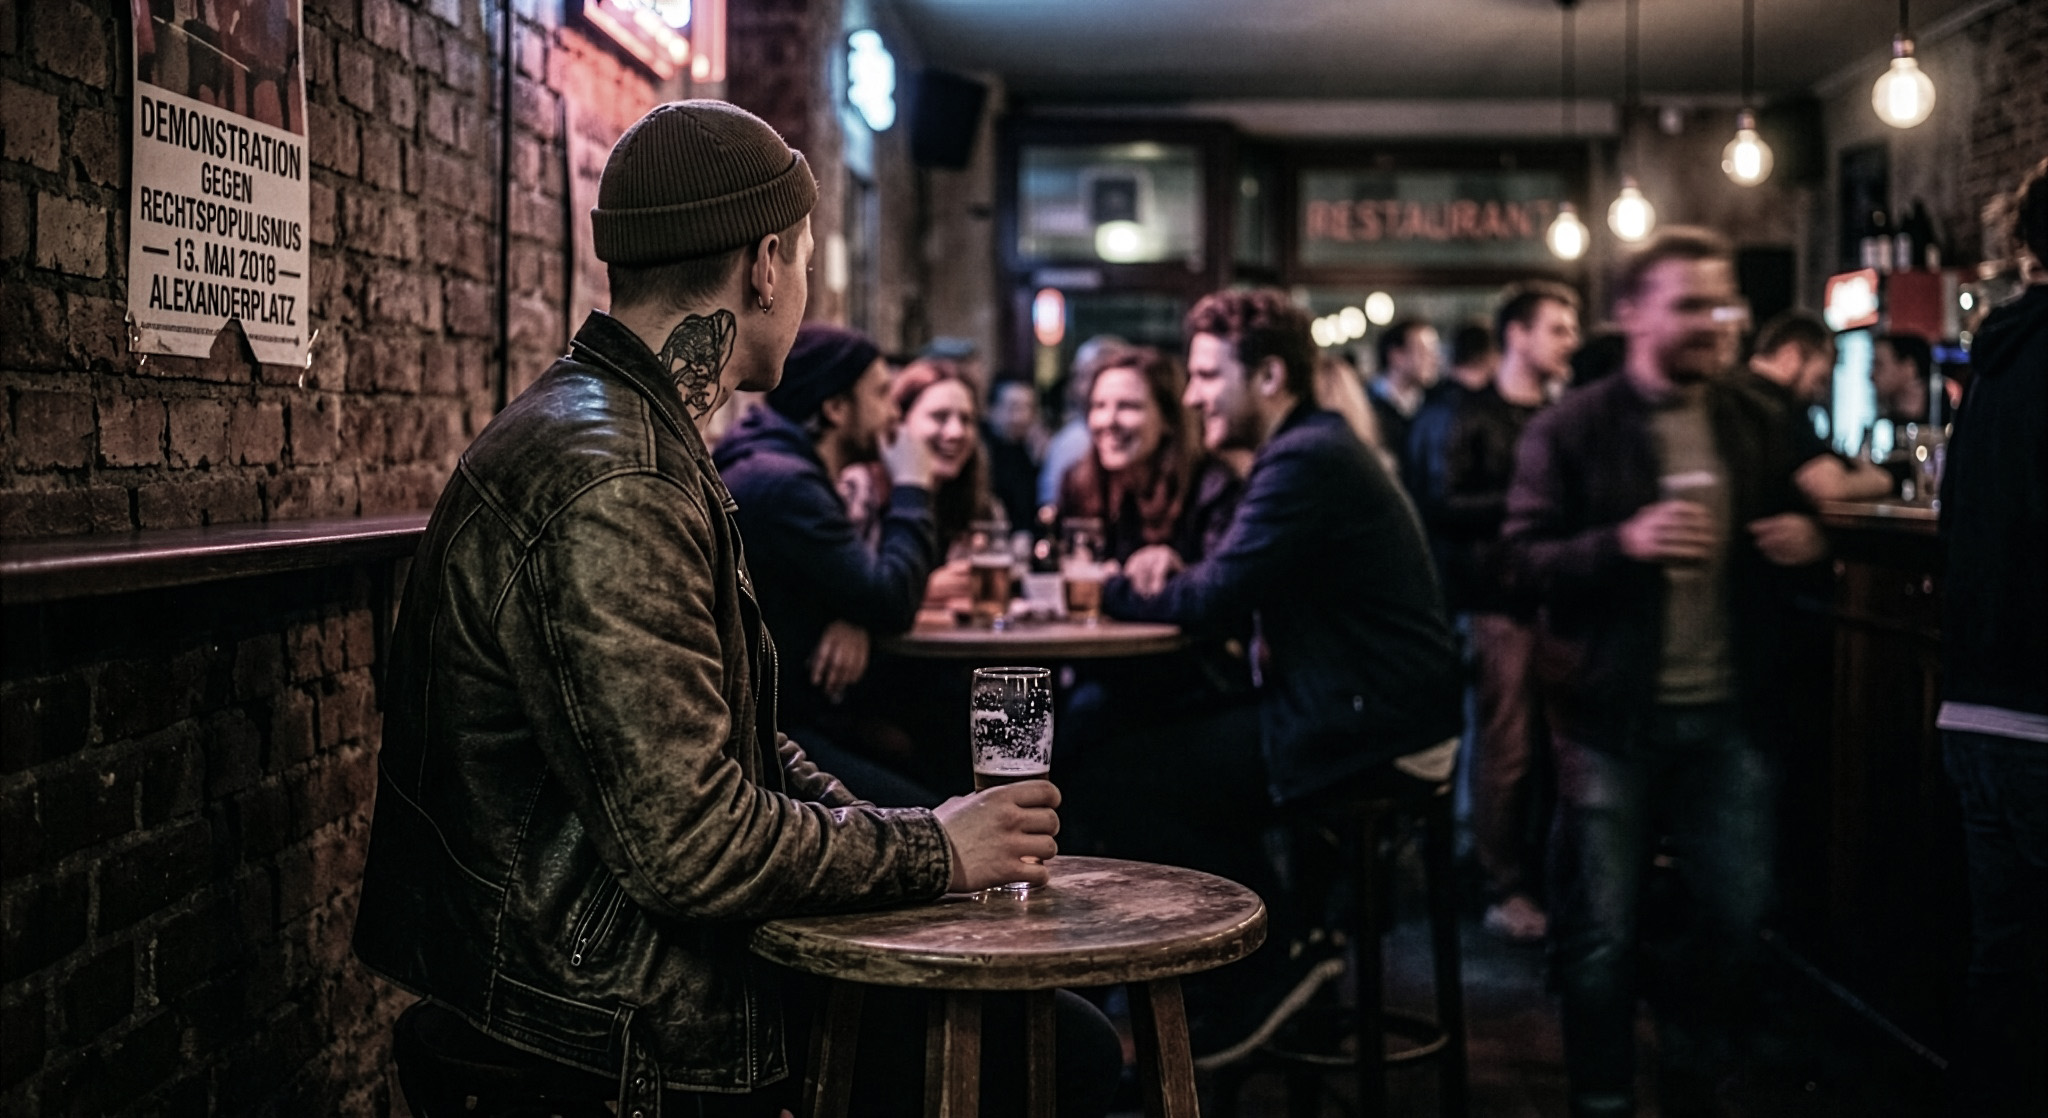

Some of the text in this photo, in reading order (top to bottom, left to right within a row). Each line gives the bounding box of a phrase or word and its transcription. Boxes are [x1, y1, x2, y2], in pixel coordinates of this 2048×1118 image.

[141, 95, 301, 181] DEMONSTRATION
[201, 161, 253, 204] GEGEN
[174, 237, 277, 286] 13. MAI 2018
[149, 274, 296, 326] ALEXANDERPLATZ
